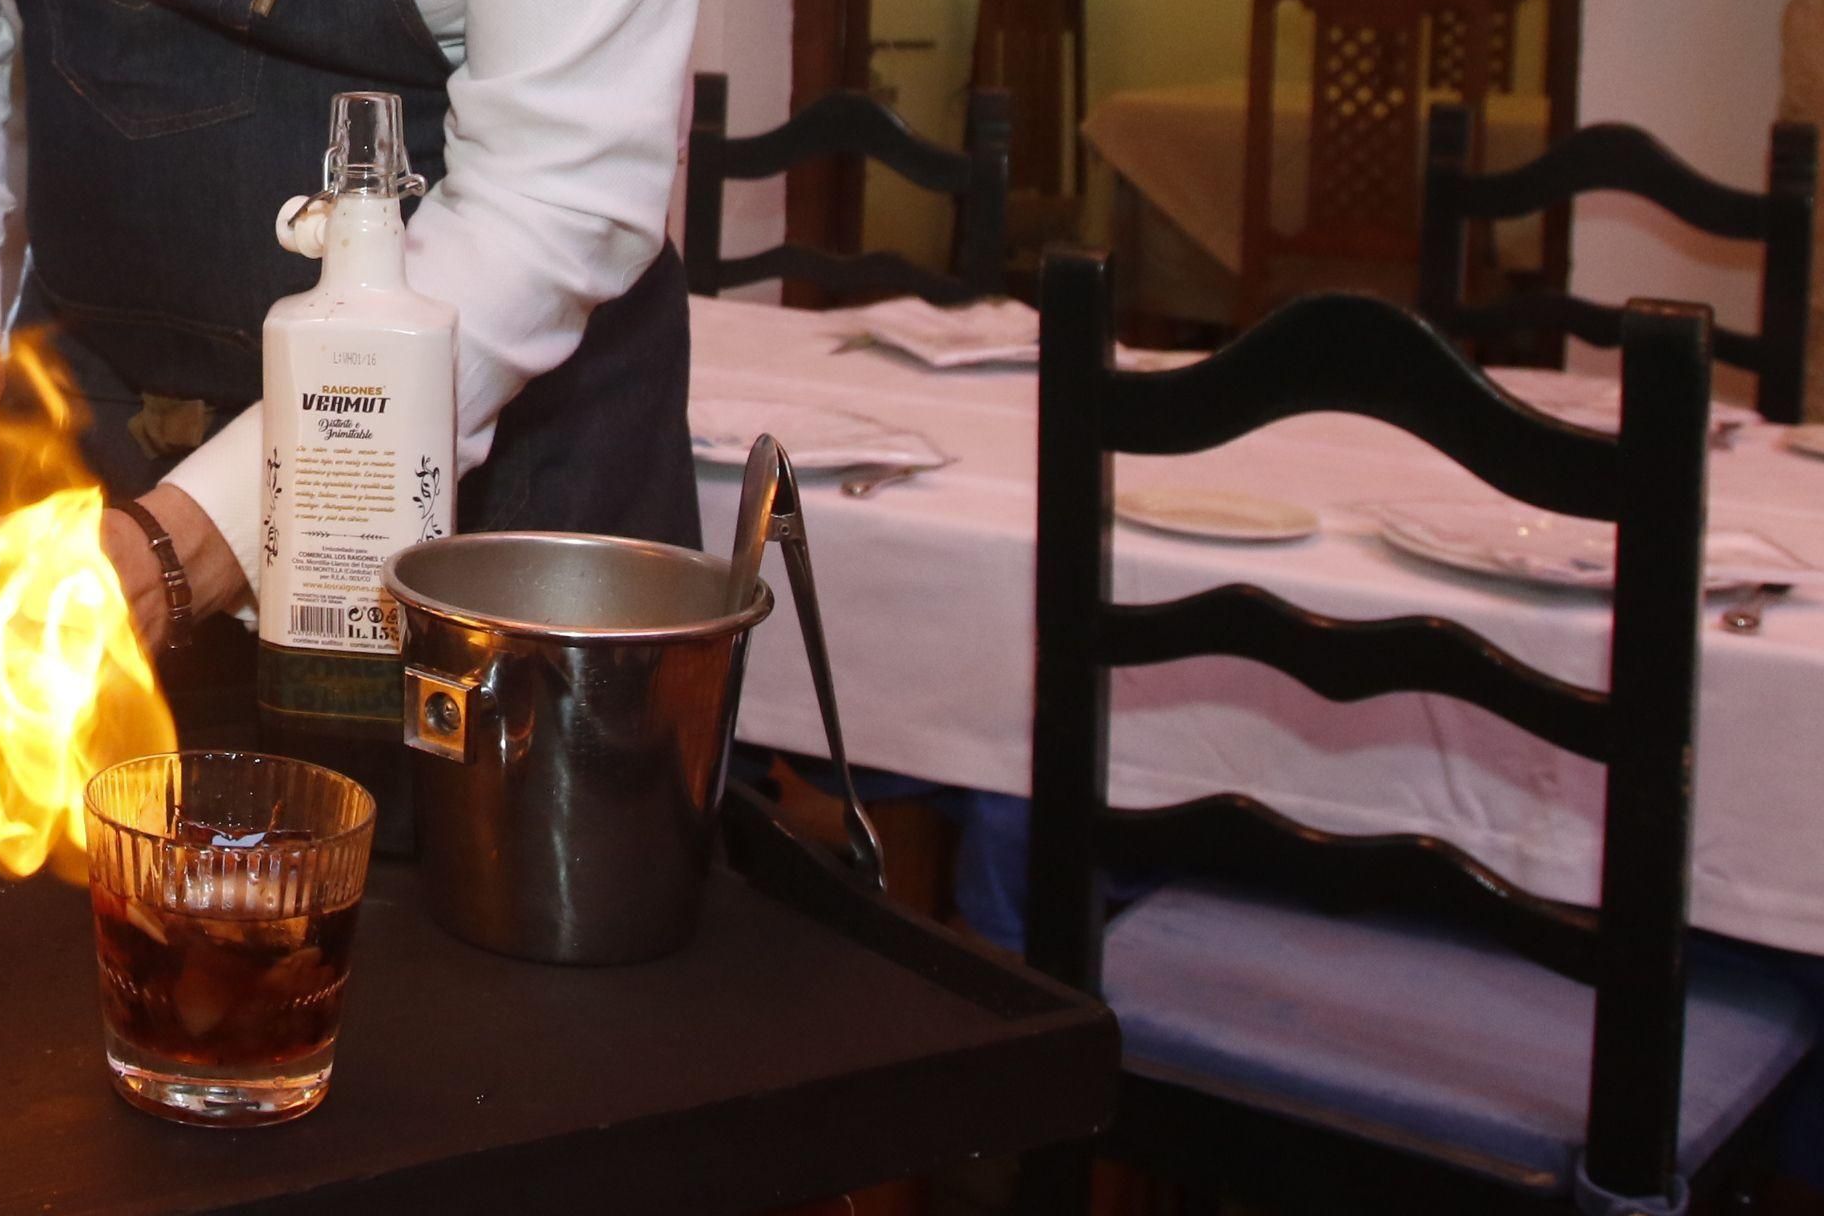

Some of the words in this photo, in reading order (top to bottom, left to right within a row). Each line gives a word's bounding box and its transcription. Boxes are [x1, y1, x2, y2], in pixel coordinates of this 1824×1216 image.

[322, 385, 383, 395] RAIGONES
[302, 392, 391, 414] VERMUT
[324, 429, 373, 441] Inimitable
[298, 551, 332, 559] COMERCIAL
[313, 566, 343, 574] MONTILLA
